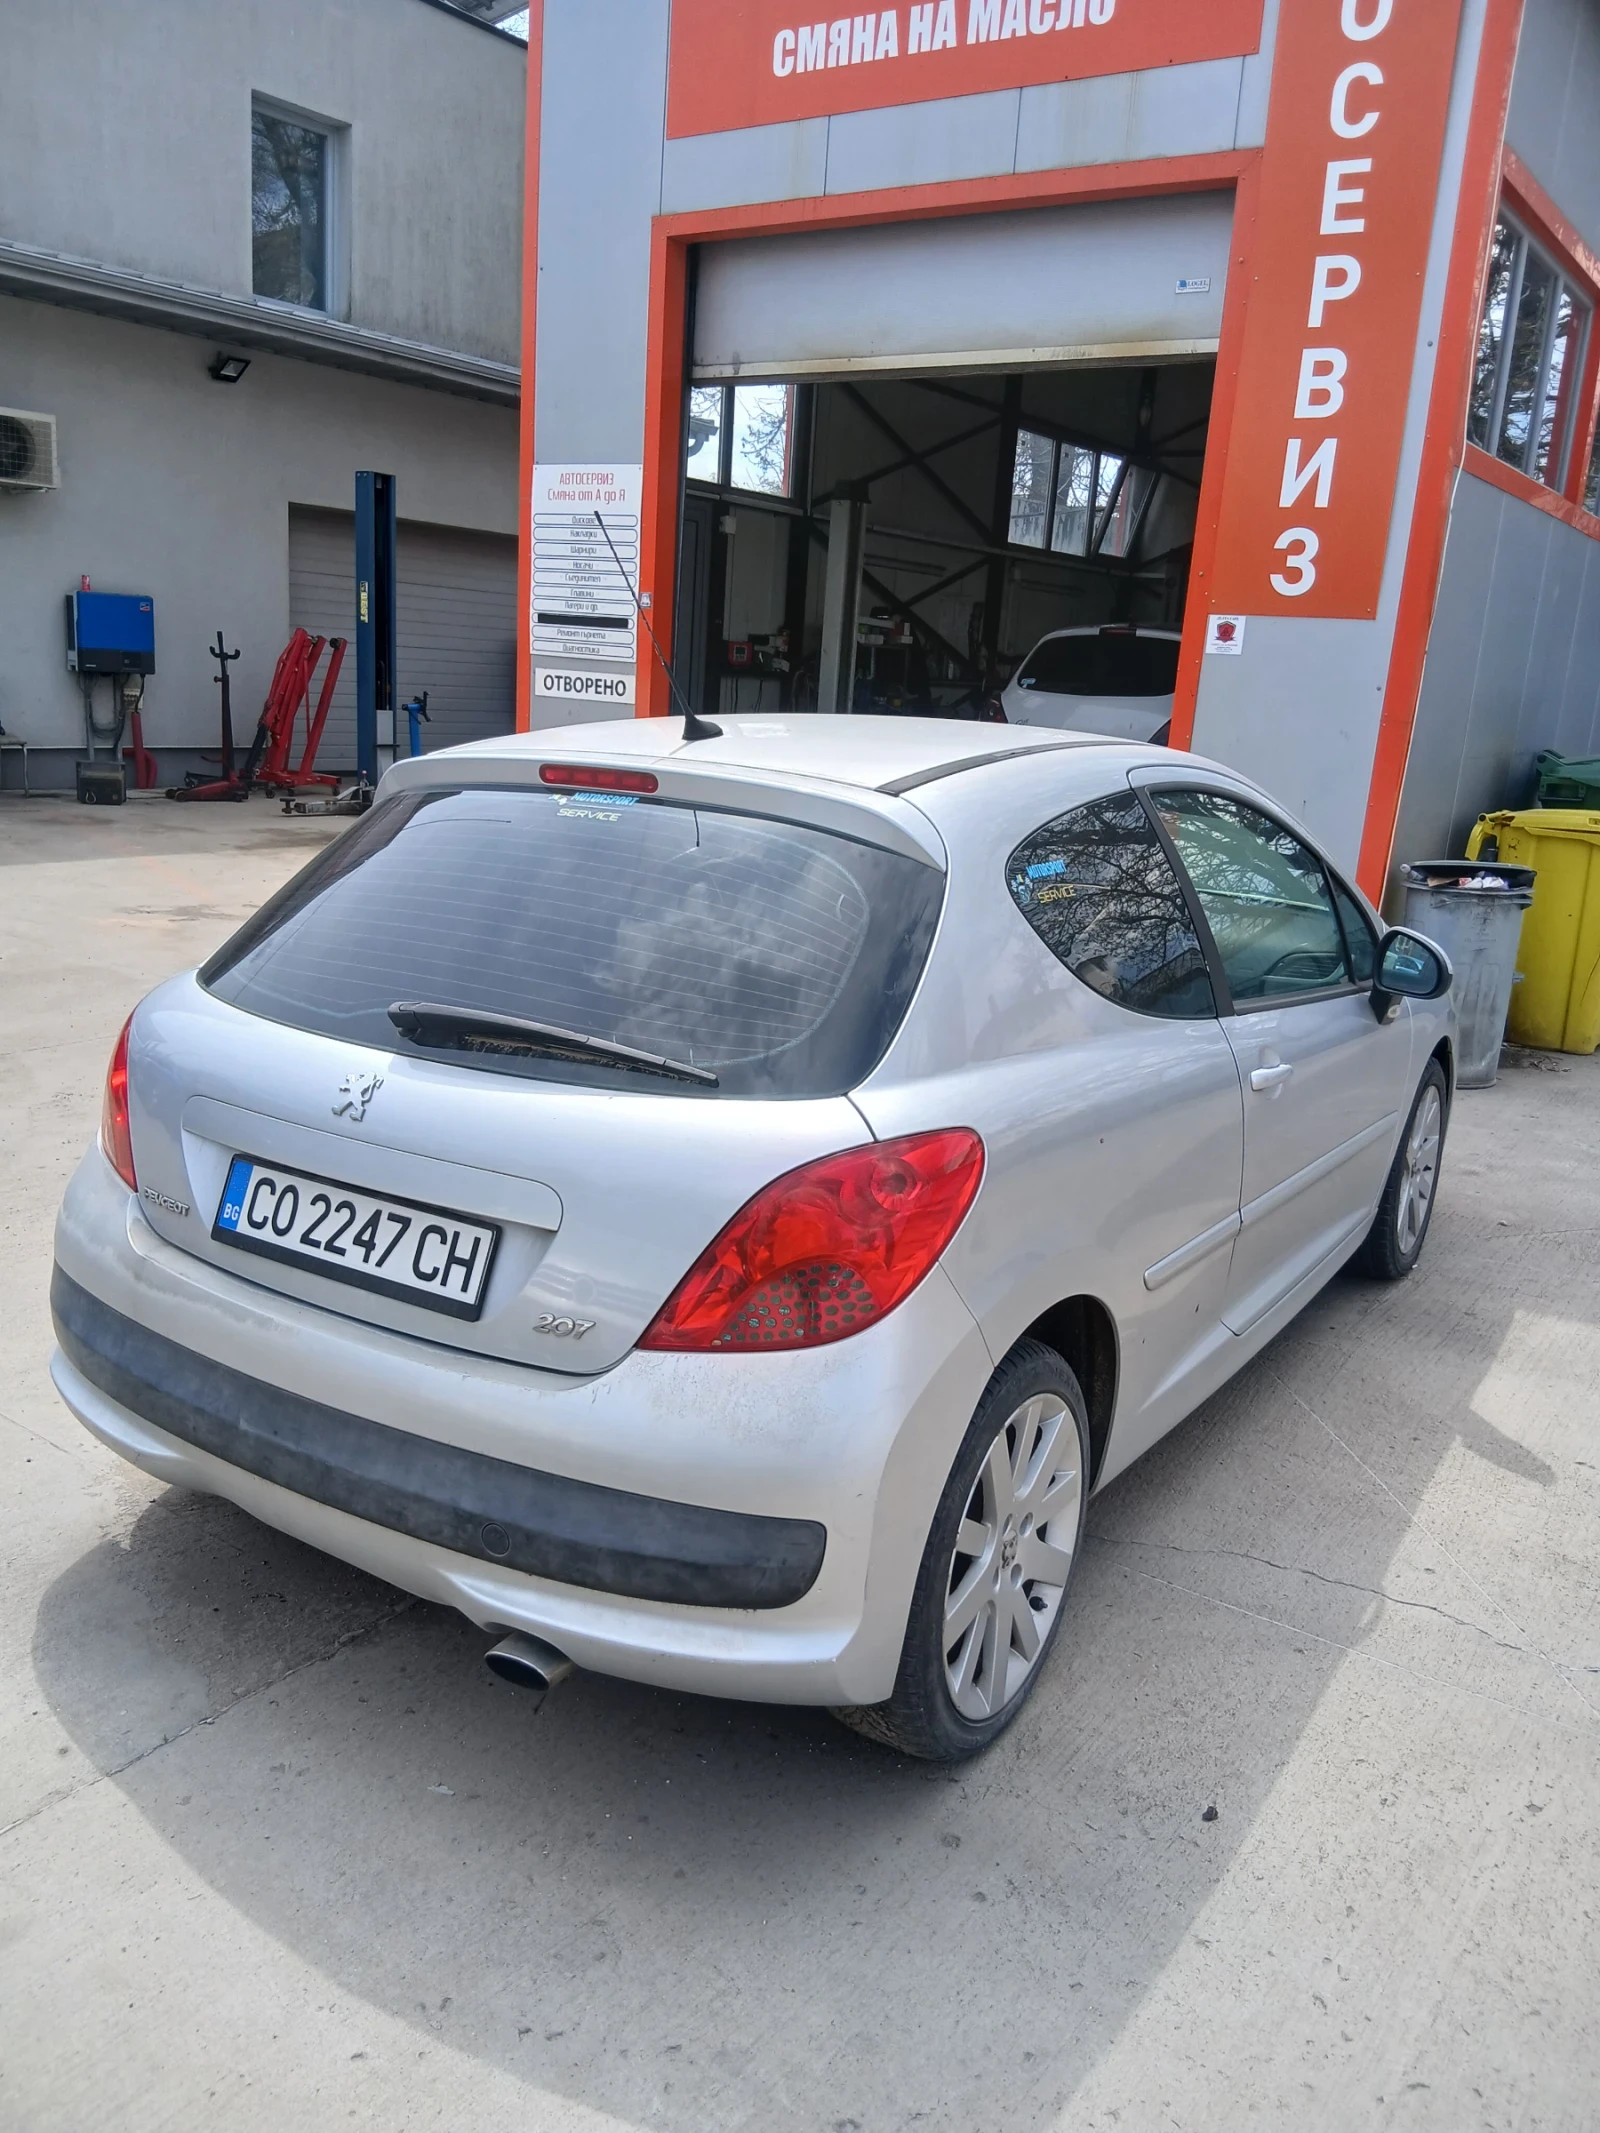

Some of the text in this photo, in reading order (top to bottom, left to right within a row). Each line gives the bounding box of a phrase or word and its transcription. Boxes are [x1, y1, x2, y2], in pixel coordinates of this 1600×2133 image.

[773, 0, 1116, 77] СМЯНА НА МАСЛО
[559, 472, 615, 486] АВТОСЕРВИЗ
[547, 488, 626, 505] Смяна от А до Я
[570, 529, 598, 540] Накладки
[570, 545, 597, 556] Шарнири
[543, 674, 627, 697] ОТВОРЕНО
[570, 792, 640, 806] MOTORSPORT
[557, 808, 622, 822] SERVICE
[1037, 884, 1077, 904] SERVICE
[143, 1185, 190, 1217] PEUGEOT
[223, 1202, 240, 1221] BG
[299, 1193, 413, 1269] 2247
[412, 1223, 482, 1293] CH
[532, 1311, 597, 1341] 207
